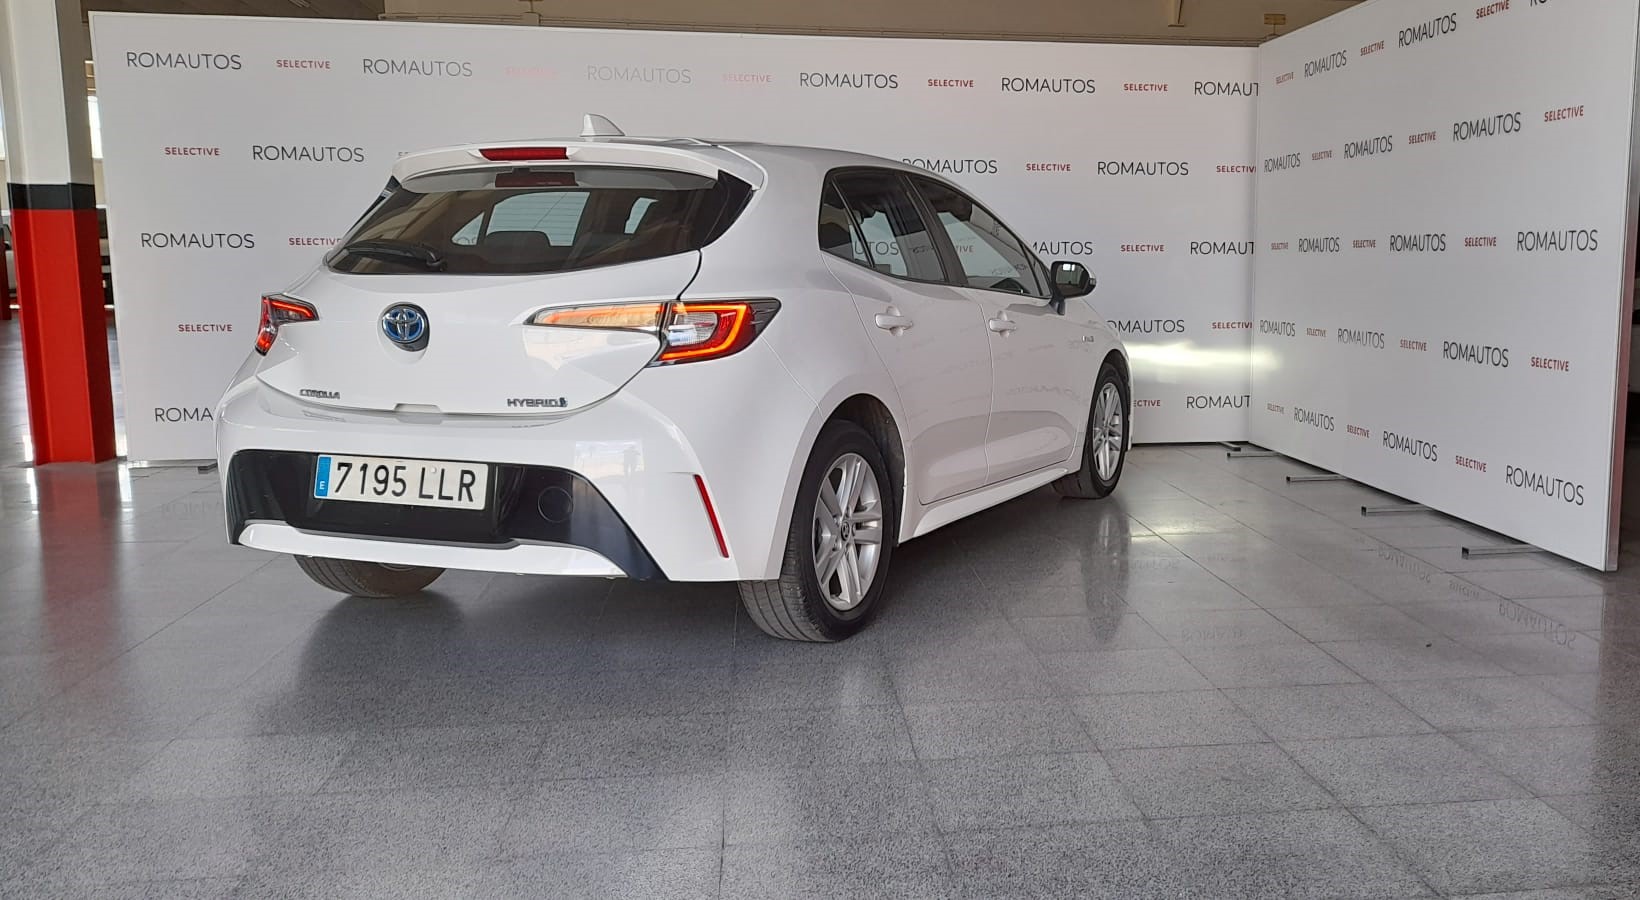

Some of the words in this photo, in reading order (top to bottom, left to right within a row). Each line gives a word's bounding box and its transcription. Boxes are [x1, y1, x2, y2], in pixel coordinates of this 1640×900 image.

[1304, 50, 1347, 78] ROMAUTOS
[1361, 40, 1384, 56] SELECTIVE
[1399, 13, 1456, 48] ROMAUTOS
[1475, 0, 1510, 19] SELECTIVE
[127, 52, 241, 70] ROMAUTOS
[276, 60, 330, 69] SELECTIVE
[363, 59, 472, 76] ROMAUTOS
[588, 65, 691, 84] ROMAUTOS
[800, 73, 898, 88] ROMAUTOS
[928, 79, 974, 87] SELECTIVE
[1002, 78, 1095, 93] ROMAUTOS
[1195, 82, 1258, 96] ROMAUT
[1264, 153, 1300, 172] ROMAUTOS
[1344, 135, 1392, 159] ROMAUTOS
[1409, 131, 1436, 144] SELECTIVE
[1453, 112, 1521, 141] ROMAUTOS
[1544, 105, 1584, 122] SELECTIVE
[165, 147, 220, 156] SELECTIVE
[253, 145, 364, 162] ROMAUTOS
[1026, 163, 1071, 171] SELECTIVE
[1098, 162, 1188, 175] ROMAUTOS
[1215, 165, 1257, 173] SELECTIV
[141, 233, 254, 248] ROMAUTOS
[288, 237, 341, 246] SELECTIV
[1032, 241, 1093, 255] AUTOS
[1191, 240, 1254, 255] ROMAUT
[1299, 237, 1340, 252] ROMAUTOS
[1353, 240, 1376, 248] SELECTIVE
[1390, 234, 1446, 251] ROMAUTOS
[1465, 237, 1496, 247] SELECTIVE
[1517, 229, 1598, 251] ROMAUTOS
[178, 324, 232, 332] SELECTIVE
[1107, 320, 1184, 333] MAUTOS
[1211, 321, 1253, 329] SELECTIV
[1260, 320, 1295, 337] ROMAUTOS
[1338, 328, 1384, 349] ROMAUTOS
[1400, 339, 1427, 351] SELECTIVE
[1443, 341, 1508, 367] ROMAUTOS
[1531, 357, 1569, 371] SELECTIVE
[154, 407, 214, 422] ROMA
[1187, 395, 1250, 409] ROMAUT
[1294, 407, 1334, 431] ROMAUTOS
[1383, 431, 1437, 462] ROMAUTOS
[1456, 455, 1486, 472] SELECTIVE
[1506, 465, 1584, 505] ROMAUTOS
[319, 481, 325, 490] E
[334, 462, 407, 497] 7195
[418, 467, 476, 502] LLR
